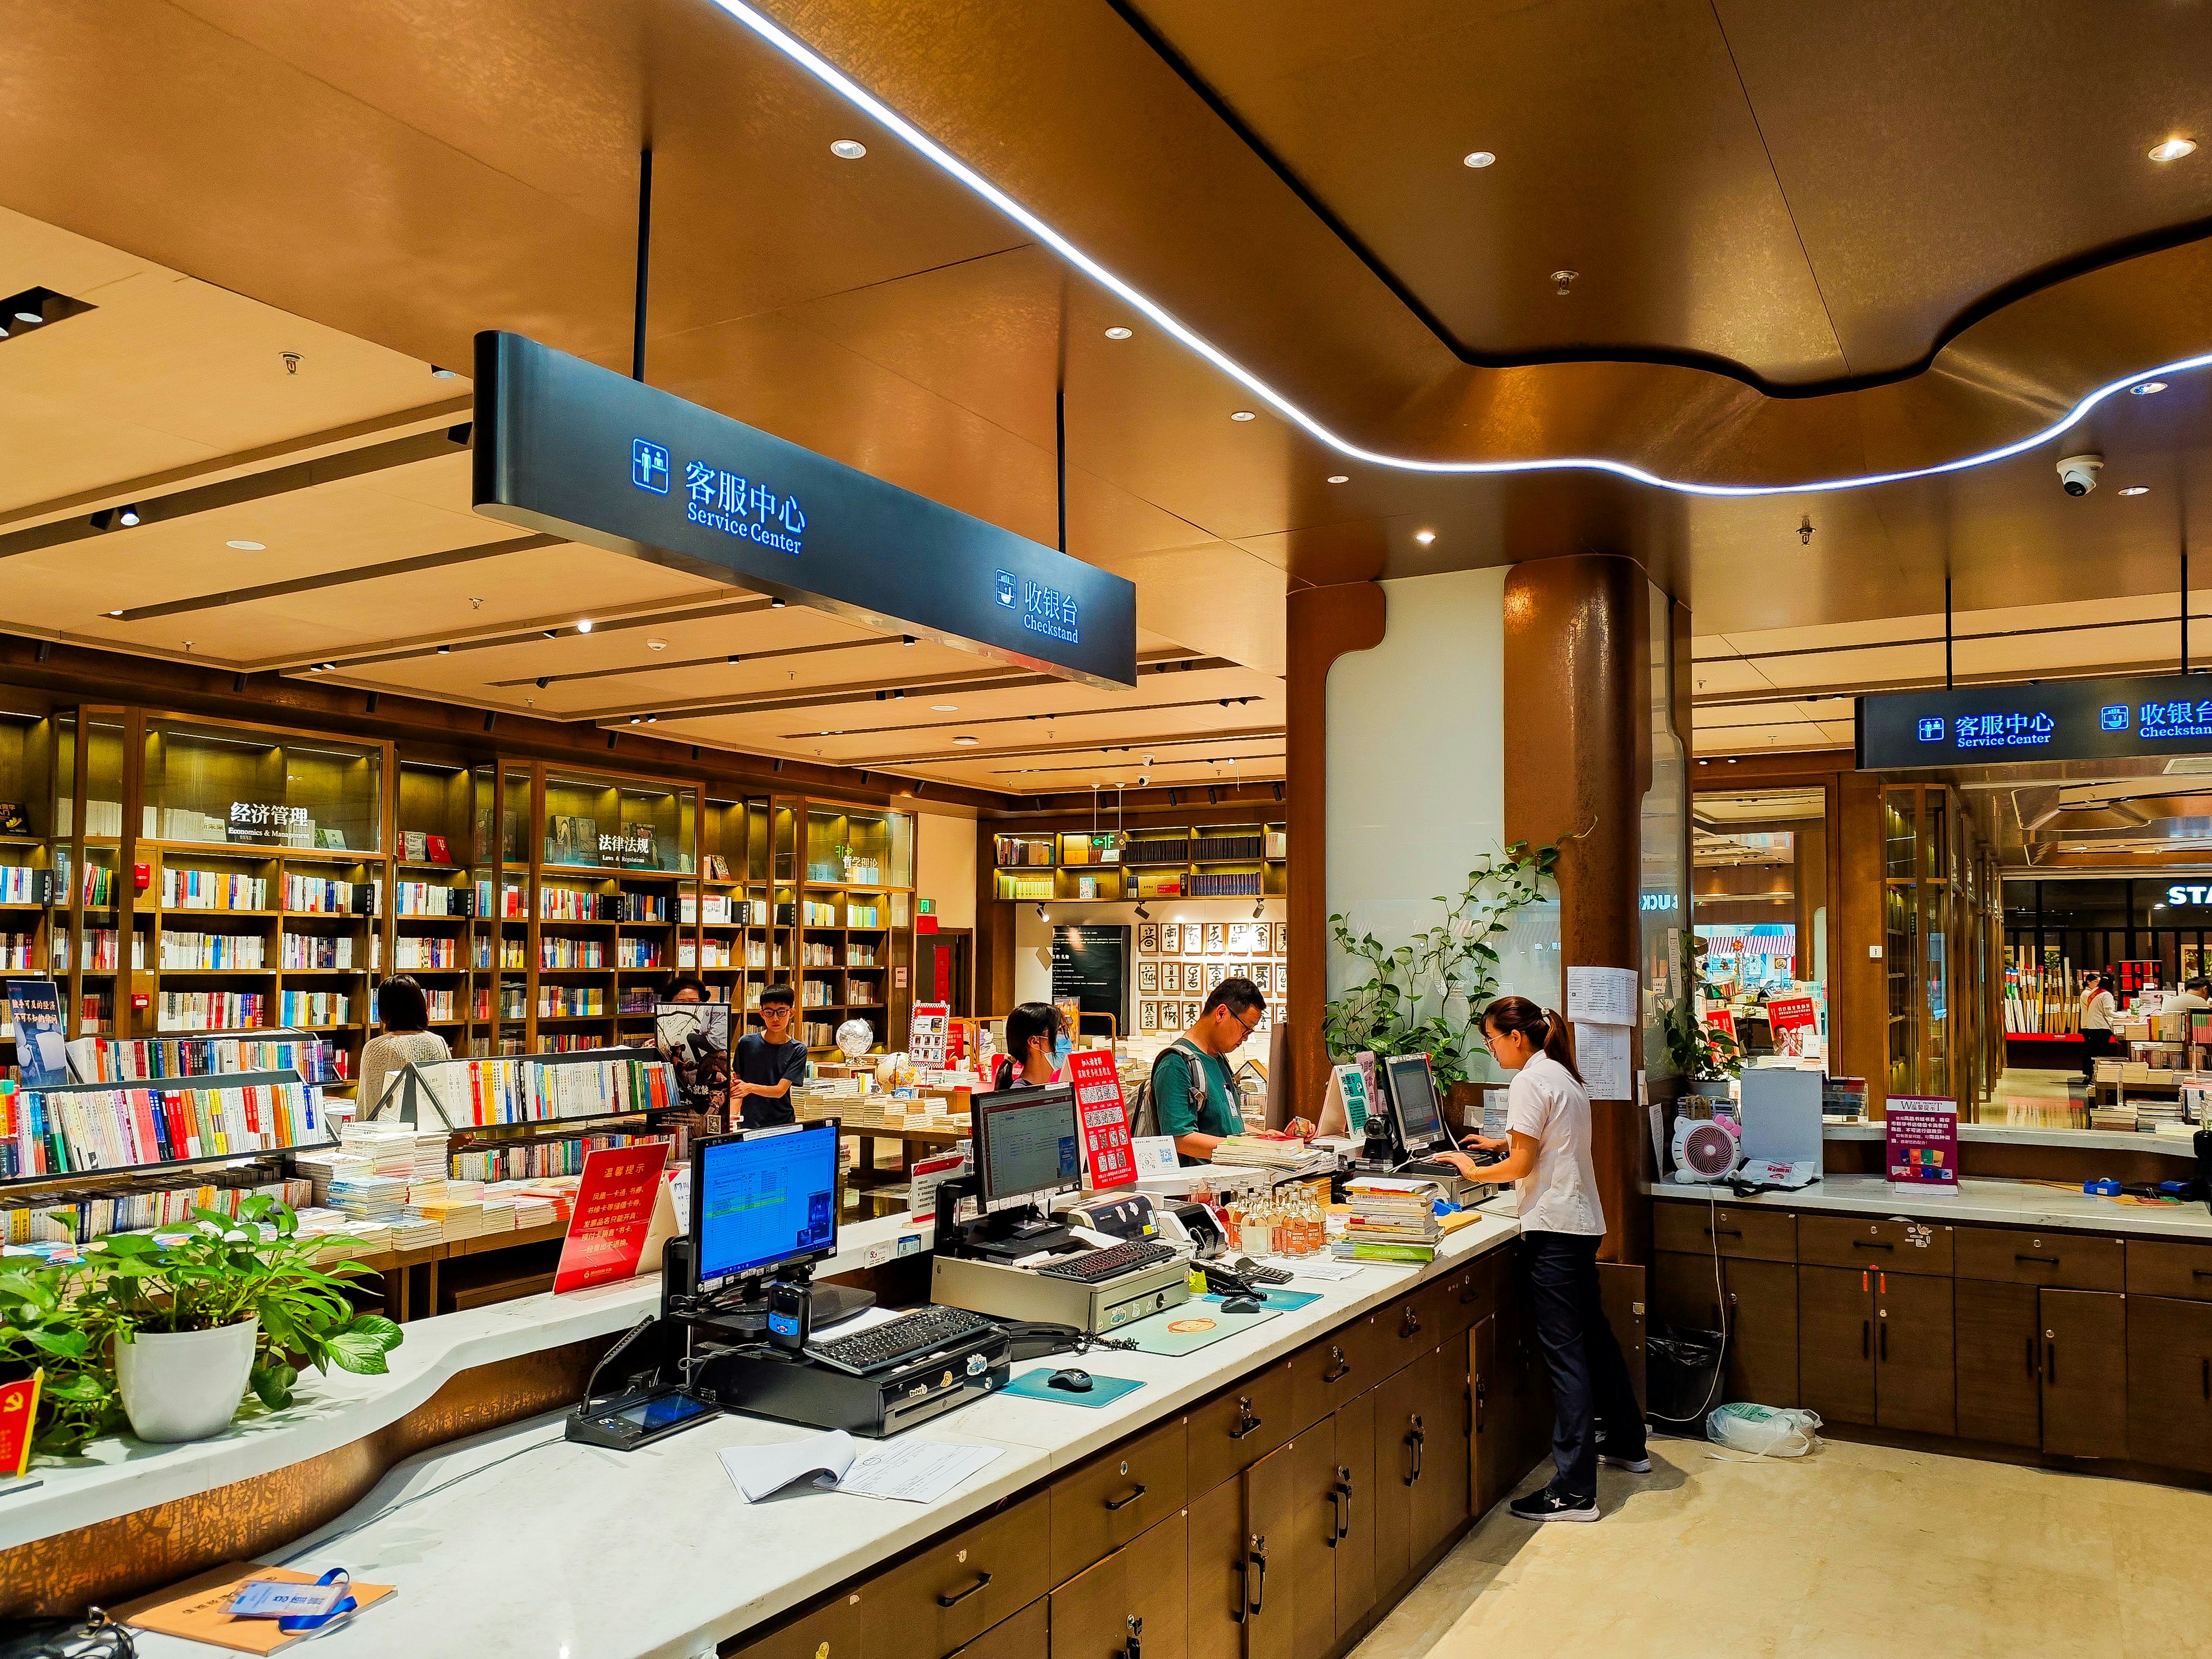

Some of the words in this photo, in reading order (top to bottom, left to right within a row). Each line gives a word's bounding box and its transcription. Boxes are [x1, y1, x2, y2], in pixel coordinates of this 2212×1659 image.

[685, 461, 806, 533] 客服中心
[687, 502, 748, 537] Service
[751, 523, 802, 554] Center
[1024, 581, 1077, 625] 收银台
[1024, 614, 1078, 643] Checkstand
[2140, 701, 2212, 725] 收银台
[1955, 712, 2055, 737] 客服中心
[1958, 736, 2005, 747] Service
[2007, 734, 2051, 745] Center
[230, 801, 308, 827] 经济管理
[228, 827, 263, 837] Economics
[272, 831, 311, 839] Management
[1103, 835, 1115, 849] 1F
[599, 834, 649, 853] 法律法规
[844, 855, 878, 870] 哲学理论
[12, 999, 55, 1011] 触手可及的经济
[14, 1013, 58, 1025] 不可不知的学问
[603, 1163, 645, 1178] 温馨提示
